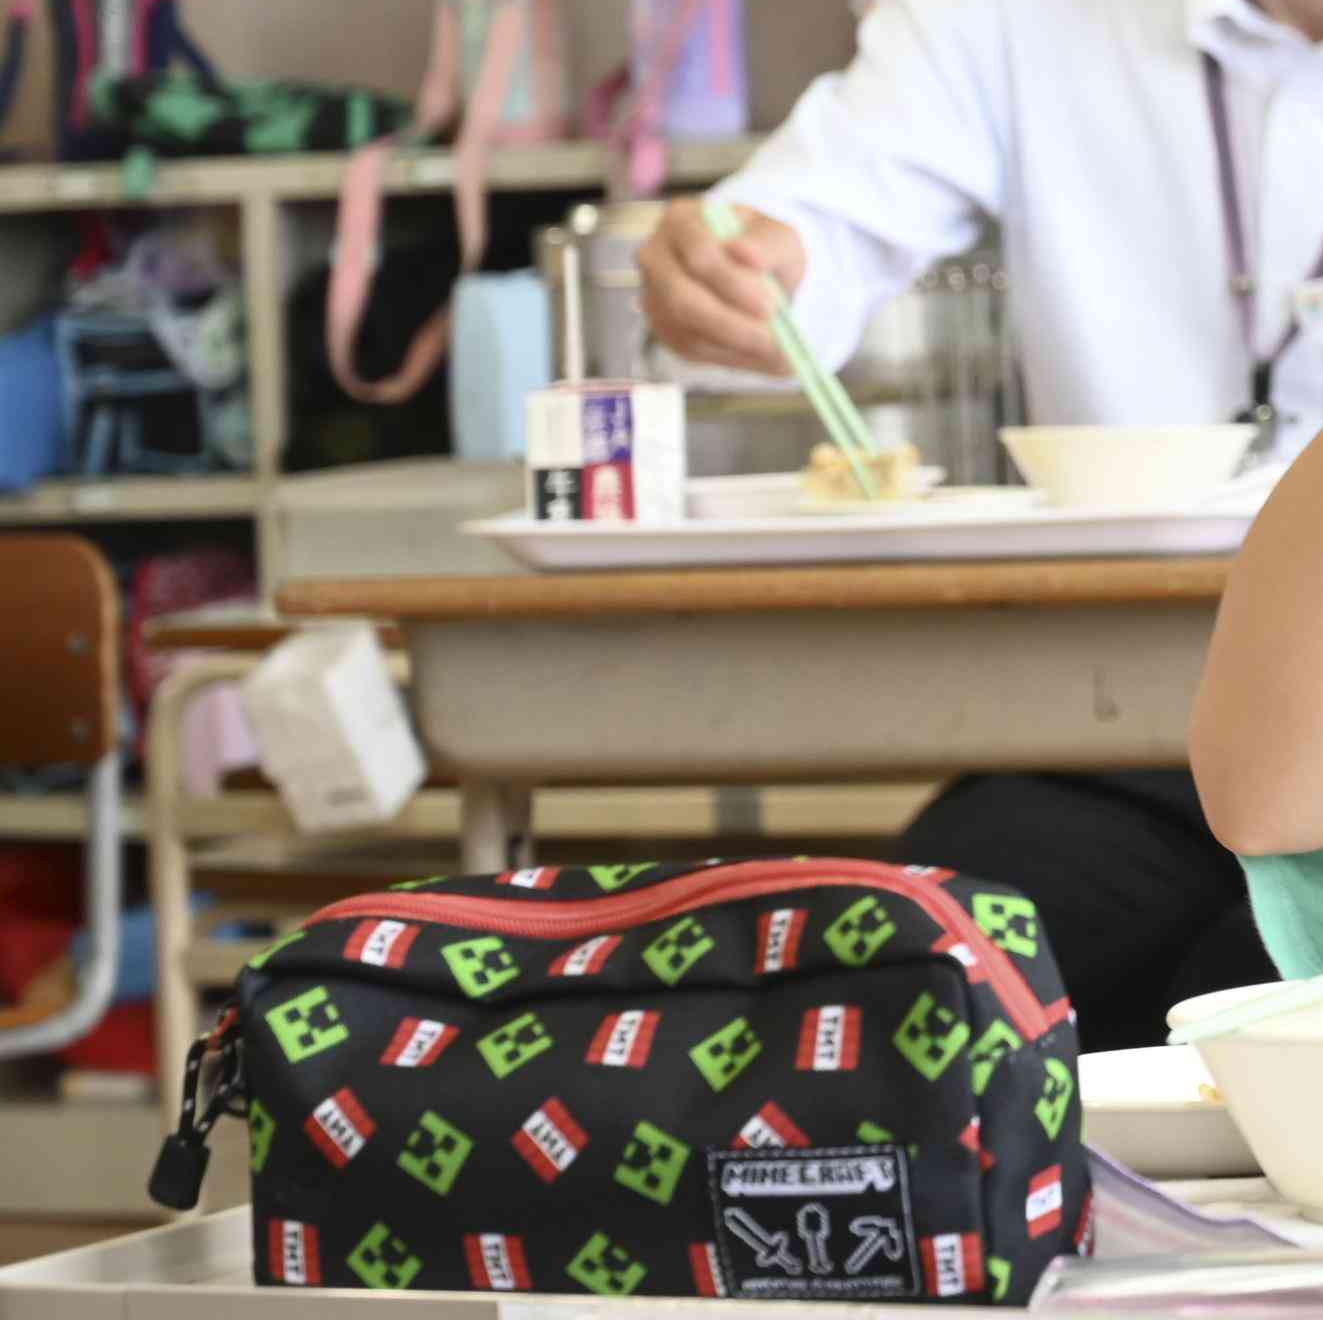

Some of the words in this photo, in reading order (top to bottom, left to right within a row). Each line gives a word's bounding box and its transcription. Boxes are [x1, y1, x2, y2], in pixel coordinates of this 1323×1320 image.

[819, 1014, 840, 1062] TNT
[722, 1159, 896, 1193] MINECRAFT
[938, 1244, 961, 1287] TNT
